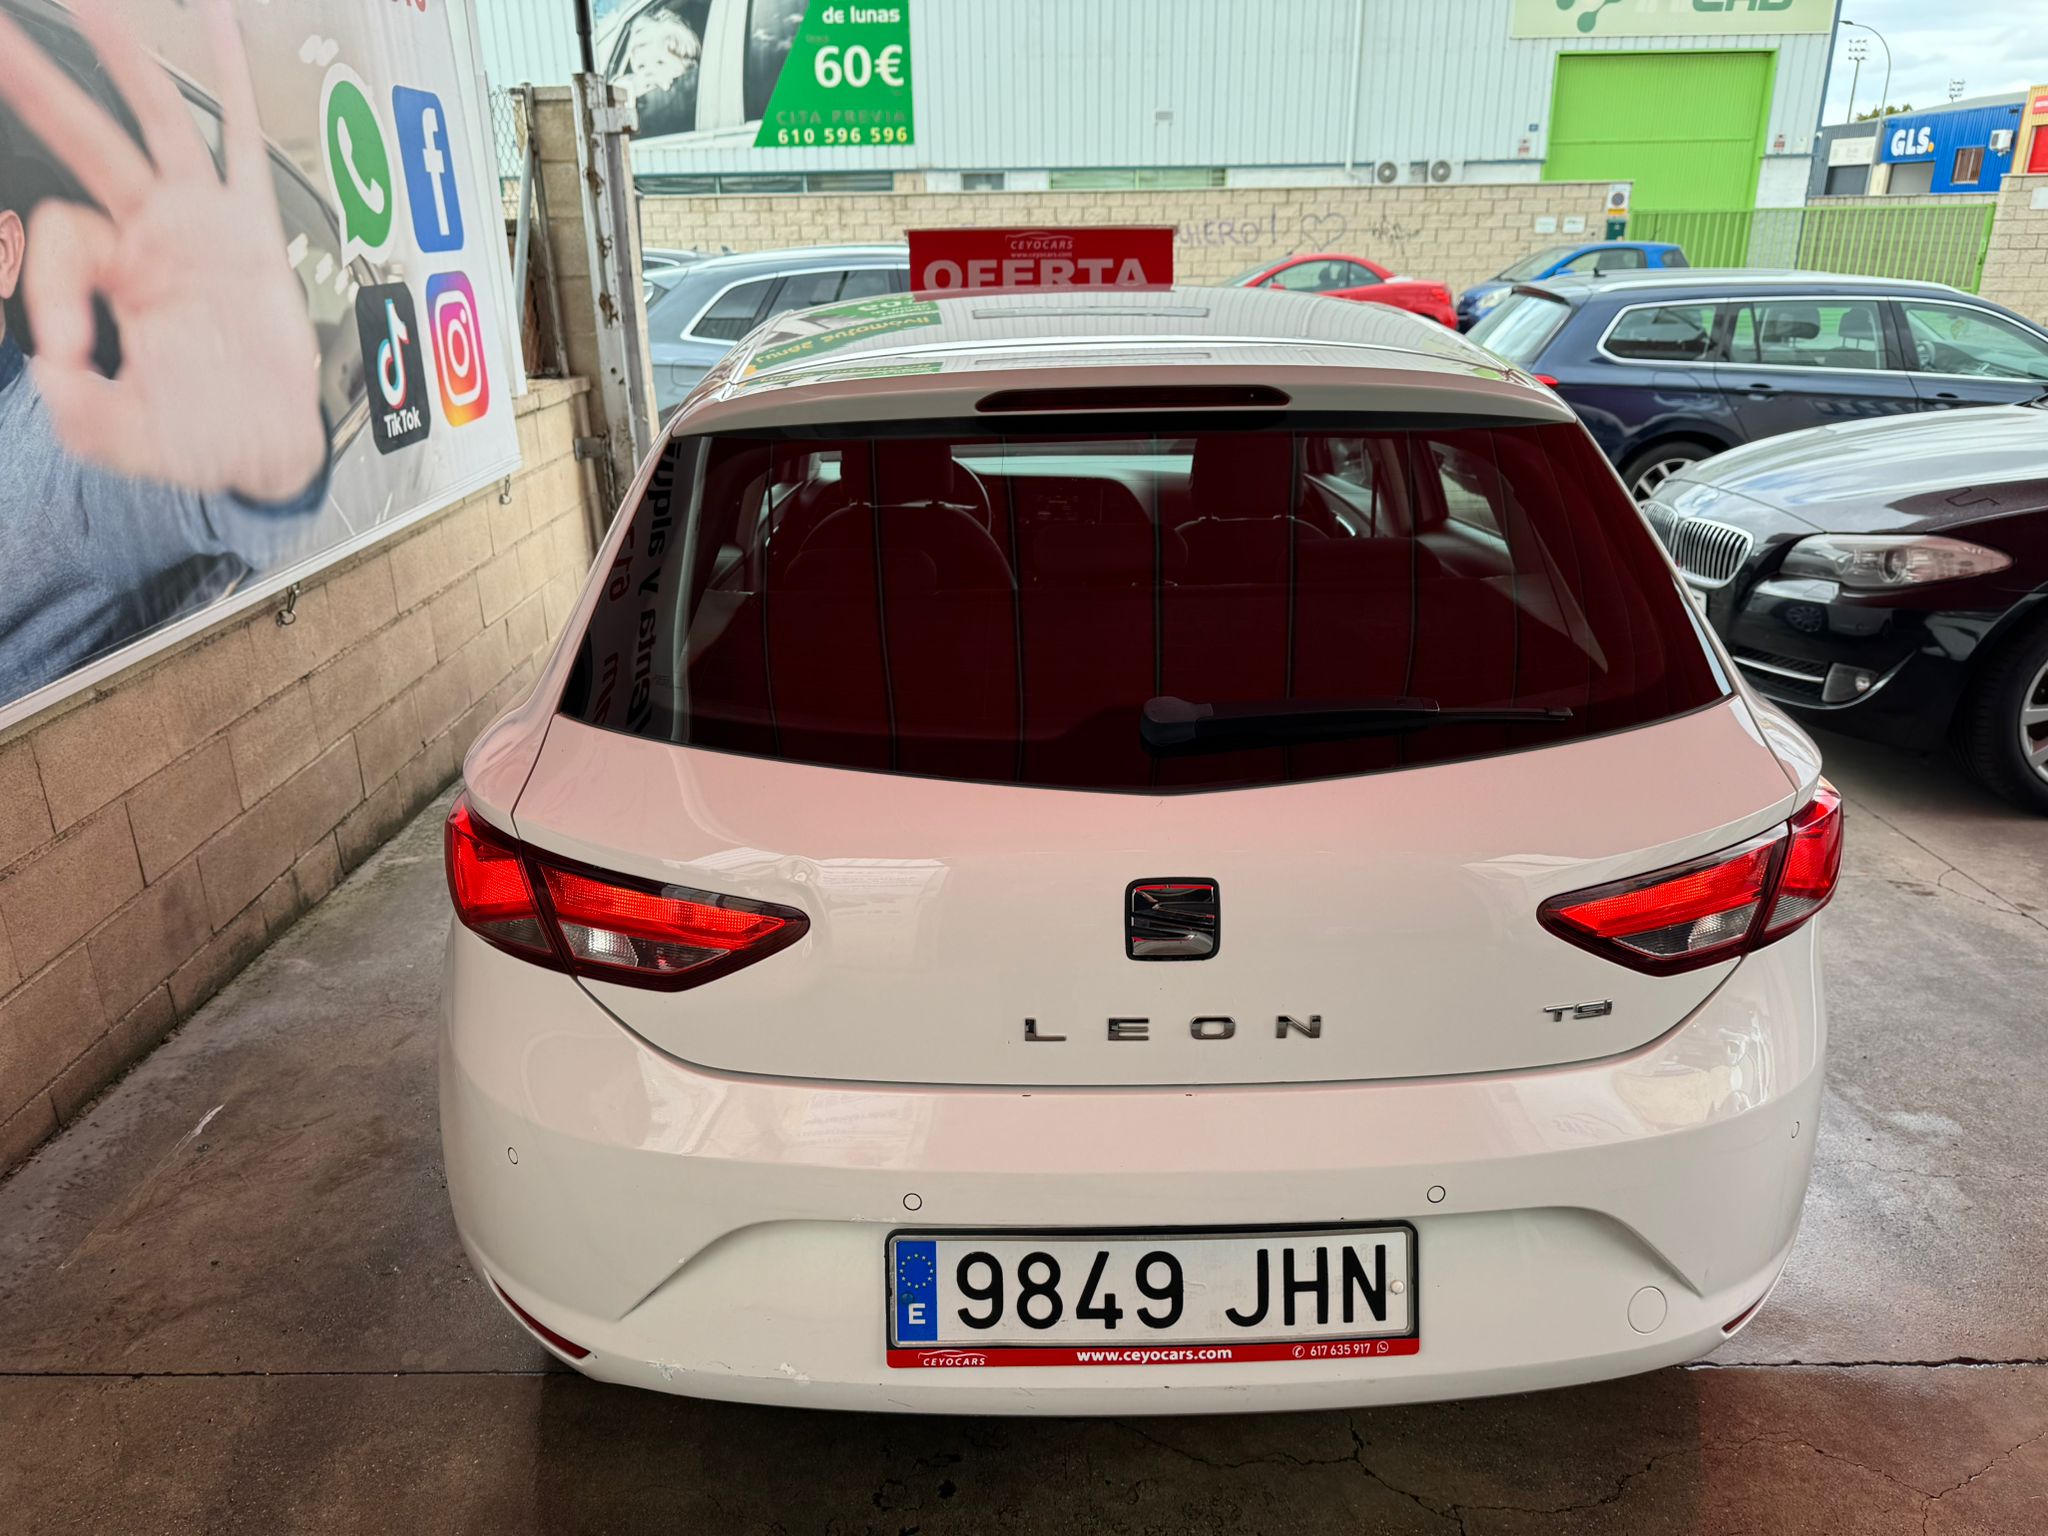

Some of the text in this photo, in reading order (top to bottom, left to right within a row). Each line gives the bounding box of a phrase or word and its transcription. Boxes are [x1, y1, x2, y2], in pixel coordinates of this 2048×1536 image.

[822, 6, 901, 24] de lunas
[814, 44, 904, 88] 60€
[777, 126, 908, 144] 610 596 596
[1010, 240, 1074, 250] CEYOCARS
[383, 405, 422, 439] TikTok
[1543, 998, 1613, 1023] TSI
[1023, 1014, 1323, 1043] LEON
[956, 1250, 1183, 1330] 9849
[1225, 1244, 1387, 1328] JHN
[907, 1303, 926, 1325] E
[1076, 1347, 1233, 1365] www.ceyocars.com
[1310, 1343, 1371, 1358] 617 635 917
[922, 1356, 986, 1367] CEYOCARS
